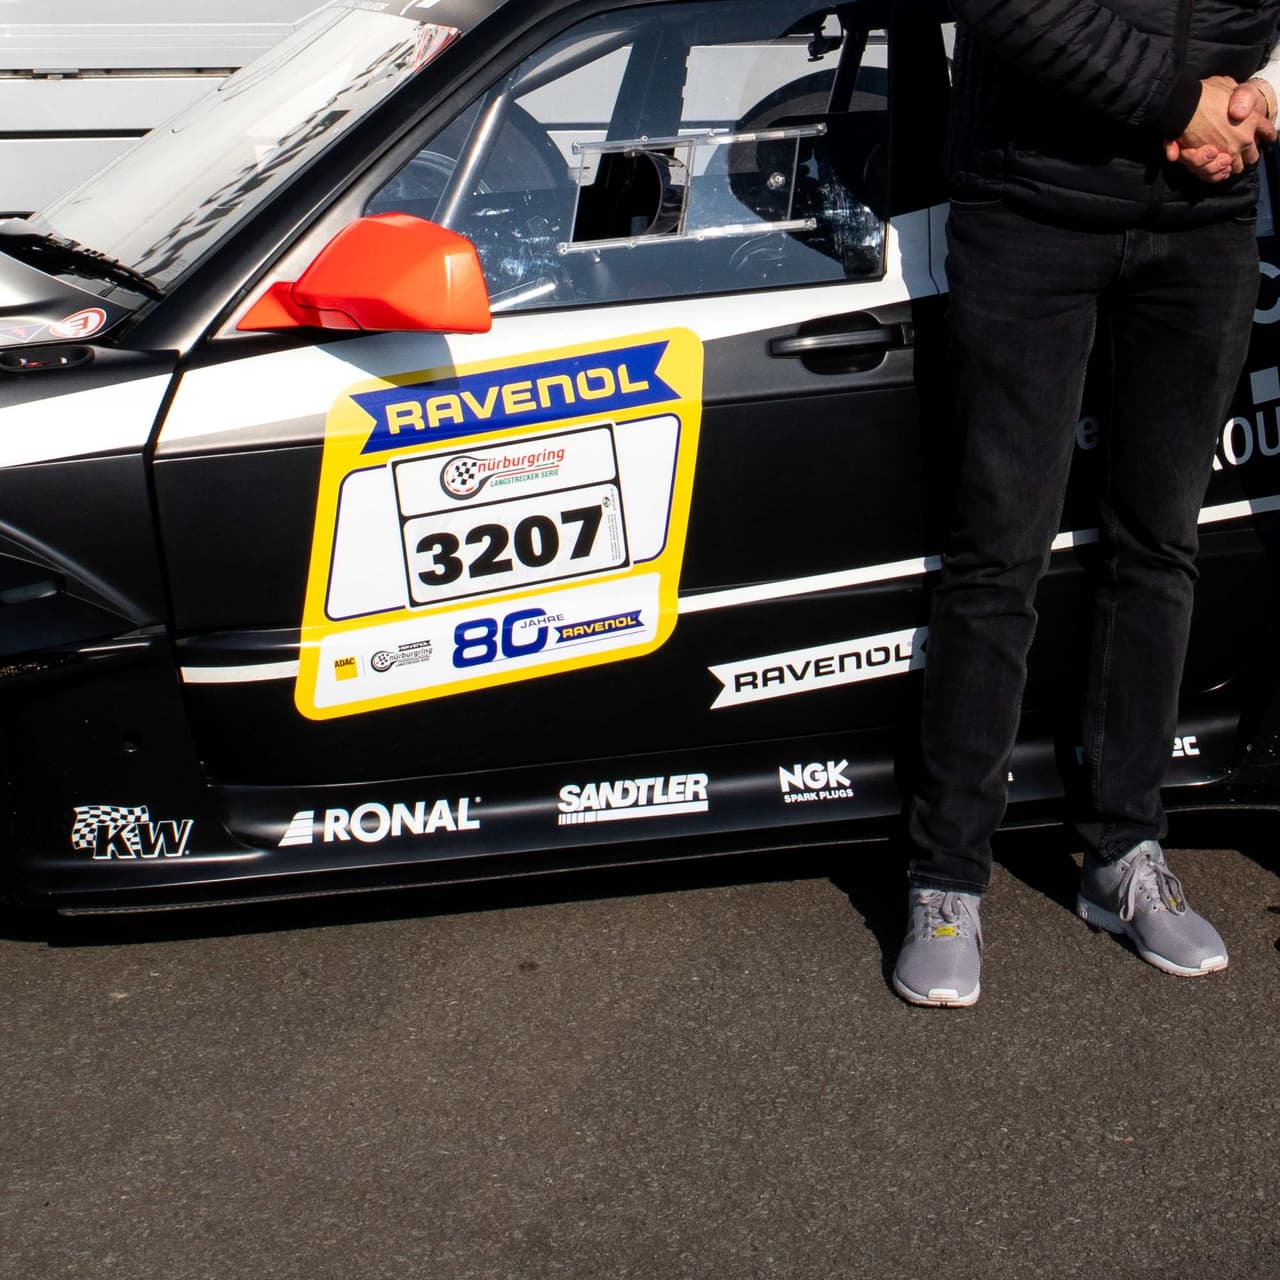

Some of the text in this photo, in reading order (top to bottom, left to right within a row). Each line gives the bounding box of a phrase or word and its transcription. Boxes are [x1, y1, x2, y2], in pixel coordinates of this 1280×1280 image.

[385, 363, 650, 436] RAVENOL
[477, 448, 566, 474] nürburgring
[415, 504, 605, 587] 3207
[452, 607, 550, 669] 80
[519, 613, 566, 630] JAHRE
[561, 615, 638, 640] RAVENOL
[334, 657, 356, 668] ADAC
[734, 642, 914, 694] RAVENOL
[558, 772, 709, 813] SANDTLER
[778, 758, 852, 793] NGK
[783, 788, 854, 804] SPARK PLUGS
[323, 796, 481, 843] RONAL
